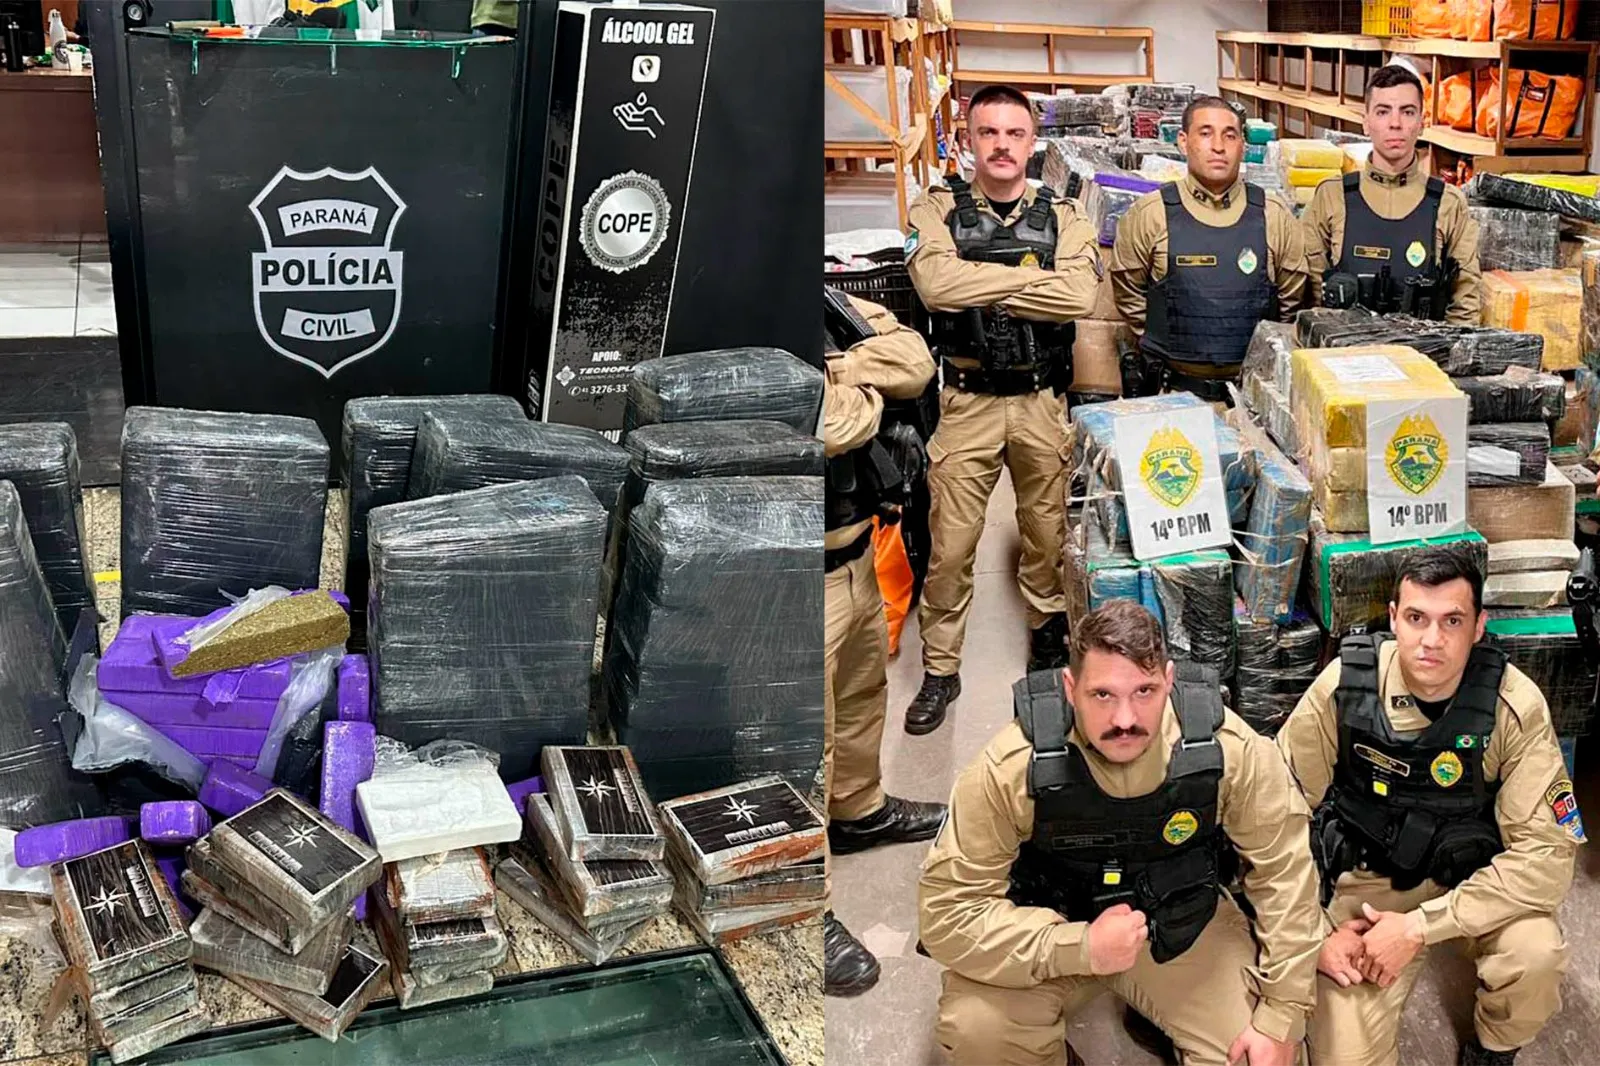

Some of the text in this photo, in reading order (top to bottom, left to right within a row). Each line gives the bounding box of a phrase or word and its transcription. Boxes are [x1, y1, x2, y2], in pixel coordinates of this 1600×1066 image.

[601, 17, 695, 44] ÁLCOOL GEL
[290, 207, 367, 228] PARANÁ
[598, 212, 653, 234] COPE
[261, 252, 393, 286] POLÍCIA
[301, 318, 356, 337] CIVIL
[592, 351, 621, 362] APOIO:
[1414, 502, 1447, 525] BPM
[1177, 512, 1211, 538] BPM
